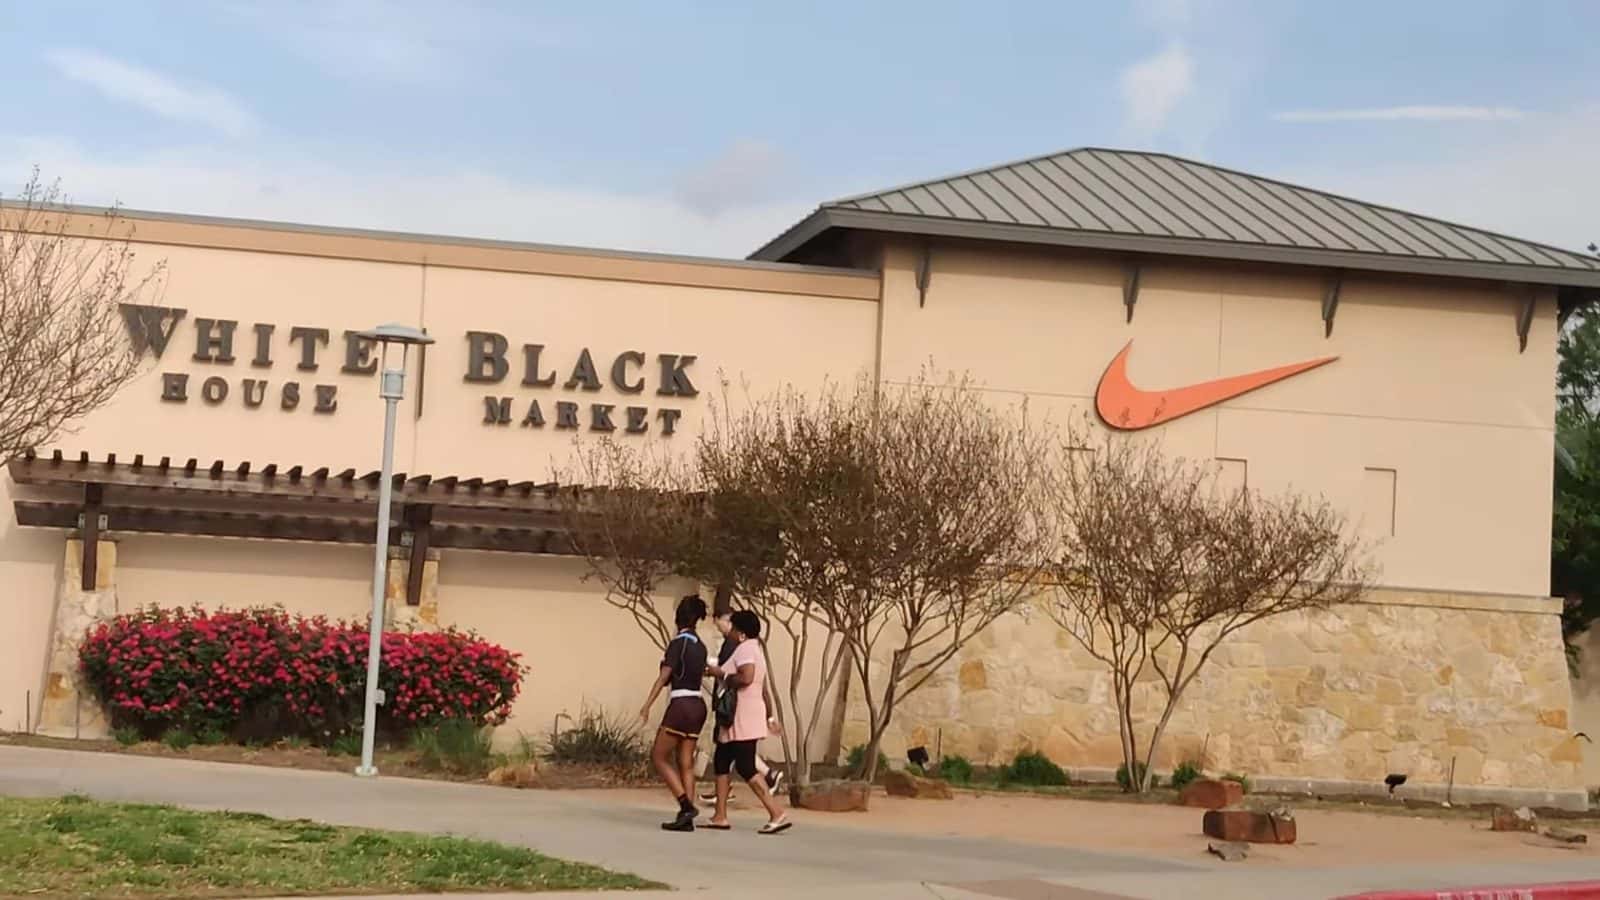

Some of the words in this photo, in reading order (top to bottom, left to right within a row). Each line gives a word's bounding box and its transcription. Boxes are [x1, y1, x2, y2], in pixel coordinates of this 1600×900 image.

[119, 303, 378, 375] WHITE
[463, 331, 699, 397] BLACK
[161, 373, 337, 413] HOUSE
[483, 396, 682, 435] MARKET
